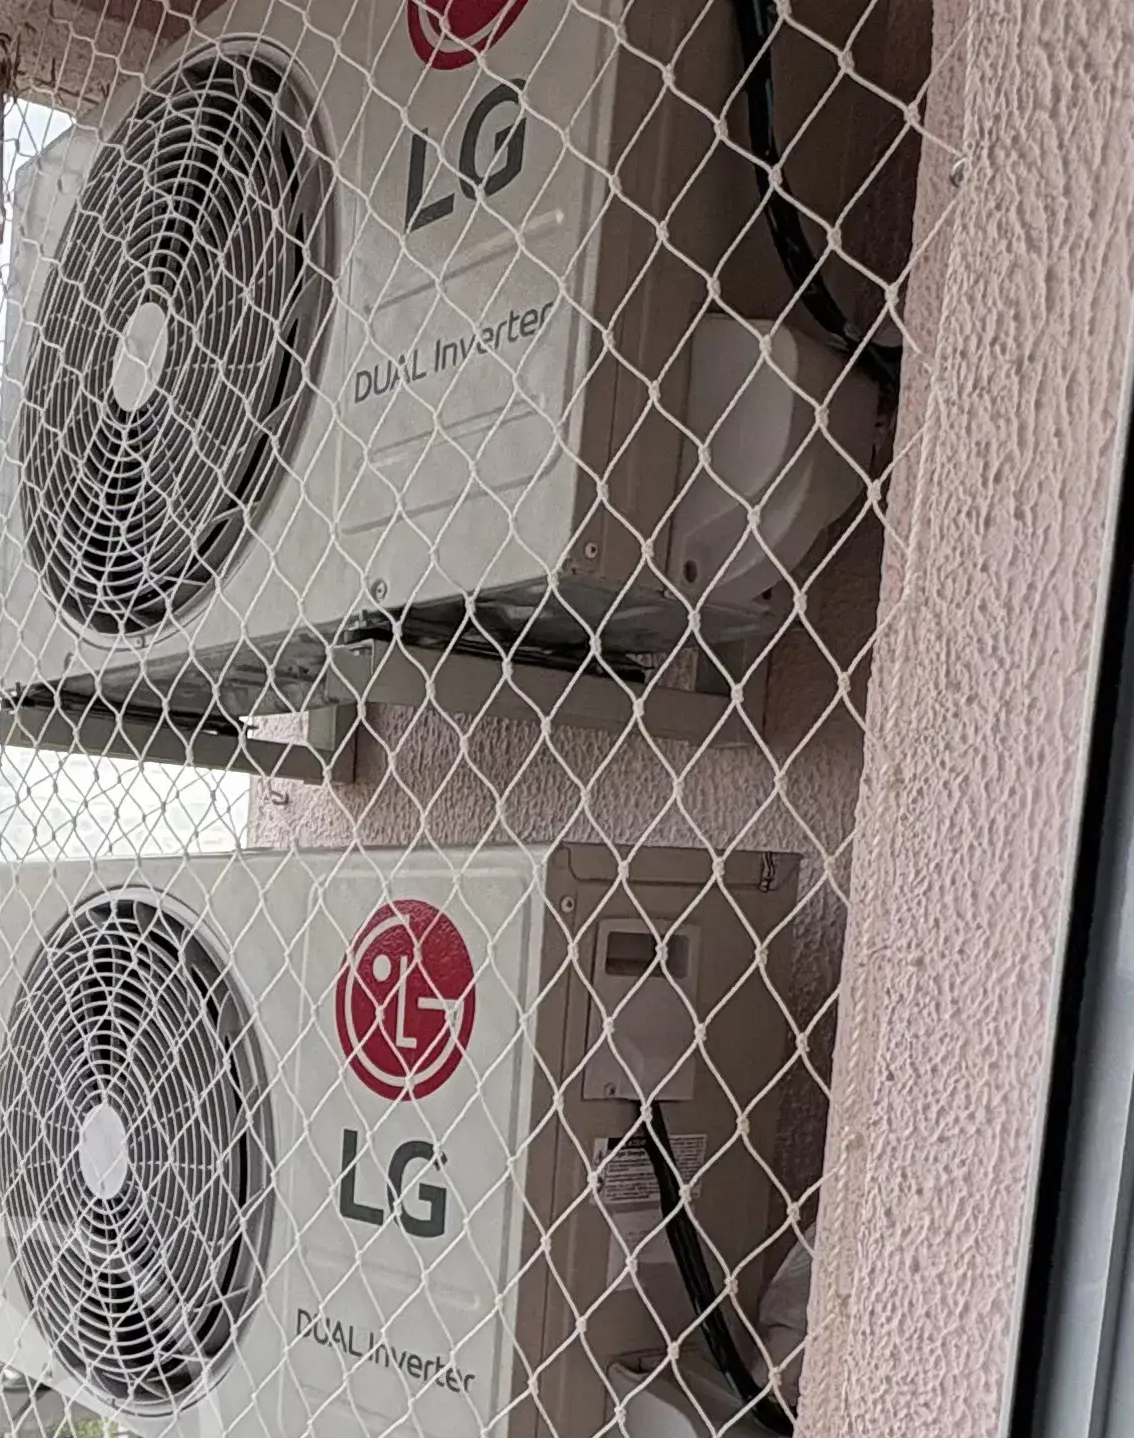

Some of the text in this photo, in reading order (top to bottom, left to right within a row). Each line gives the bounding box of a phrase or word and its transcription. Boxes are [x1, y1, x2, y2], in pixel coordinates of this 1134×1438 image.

[406, 78, 526, 233] LG
[354, 301, 554, 404] DUAL Inverter
[339, 1129, 448, 1238] LG
[297, 1308, 476, 1393] DUAL Inverter
